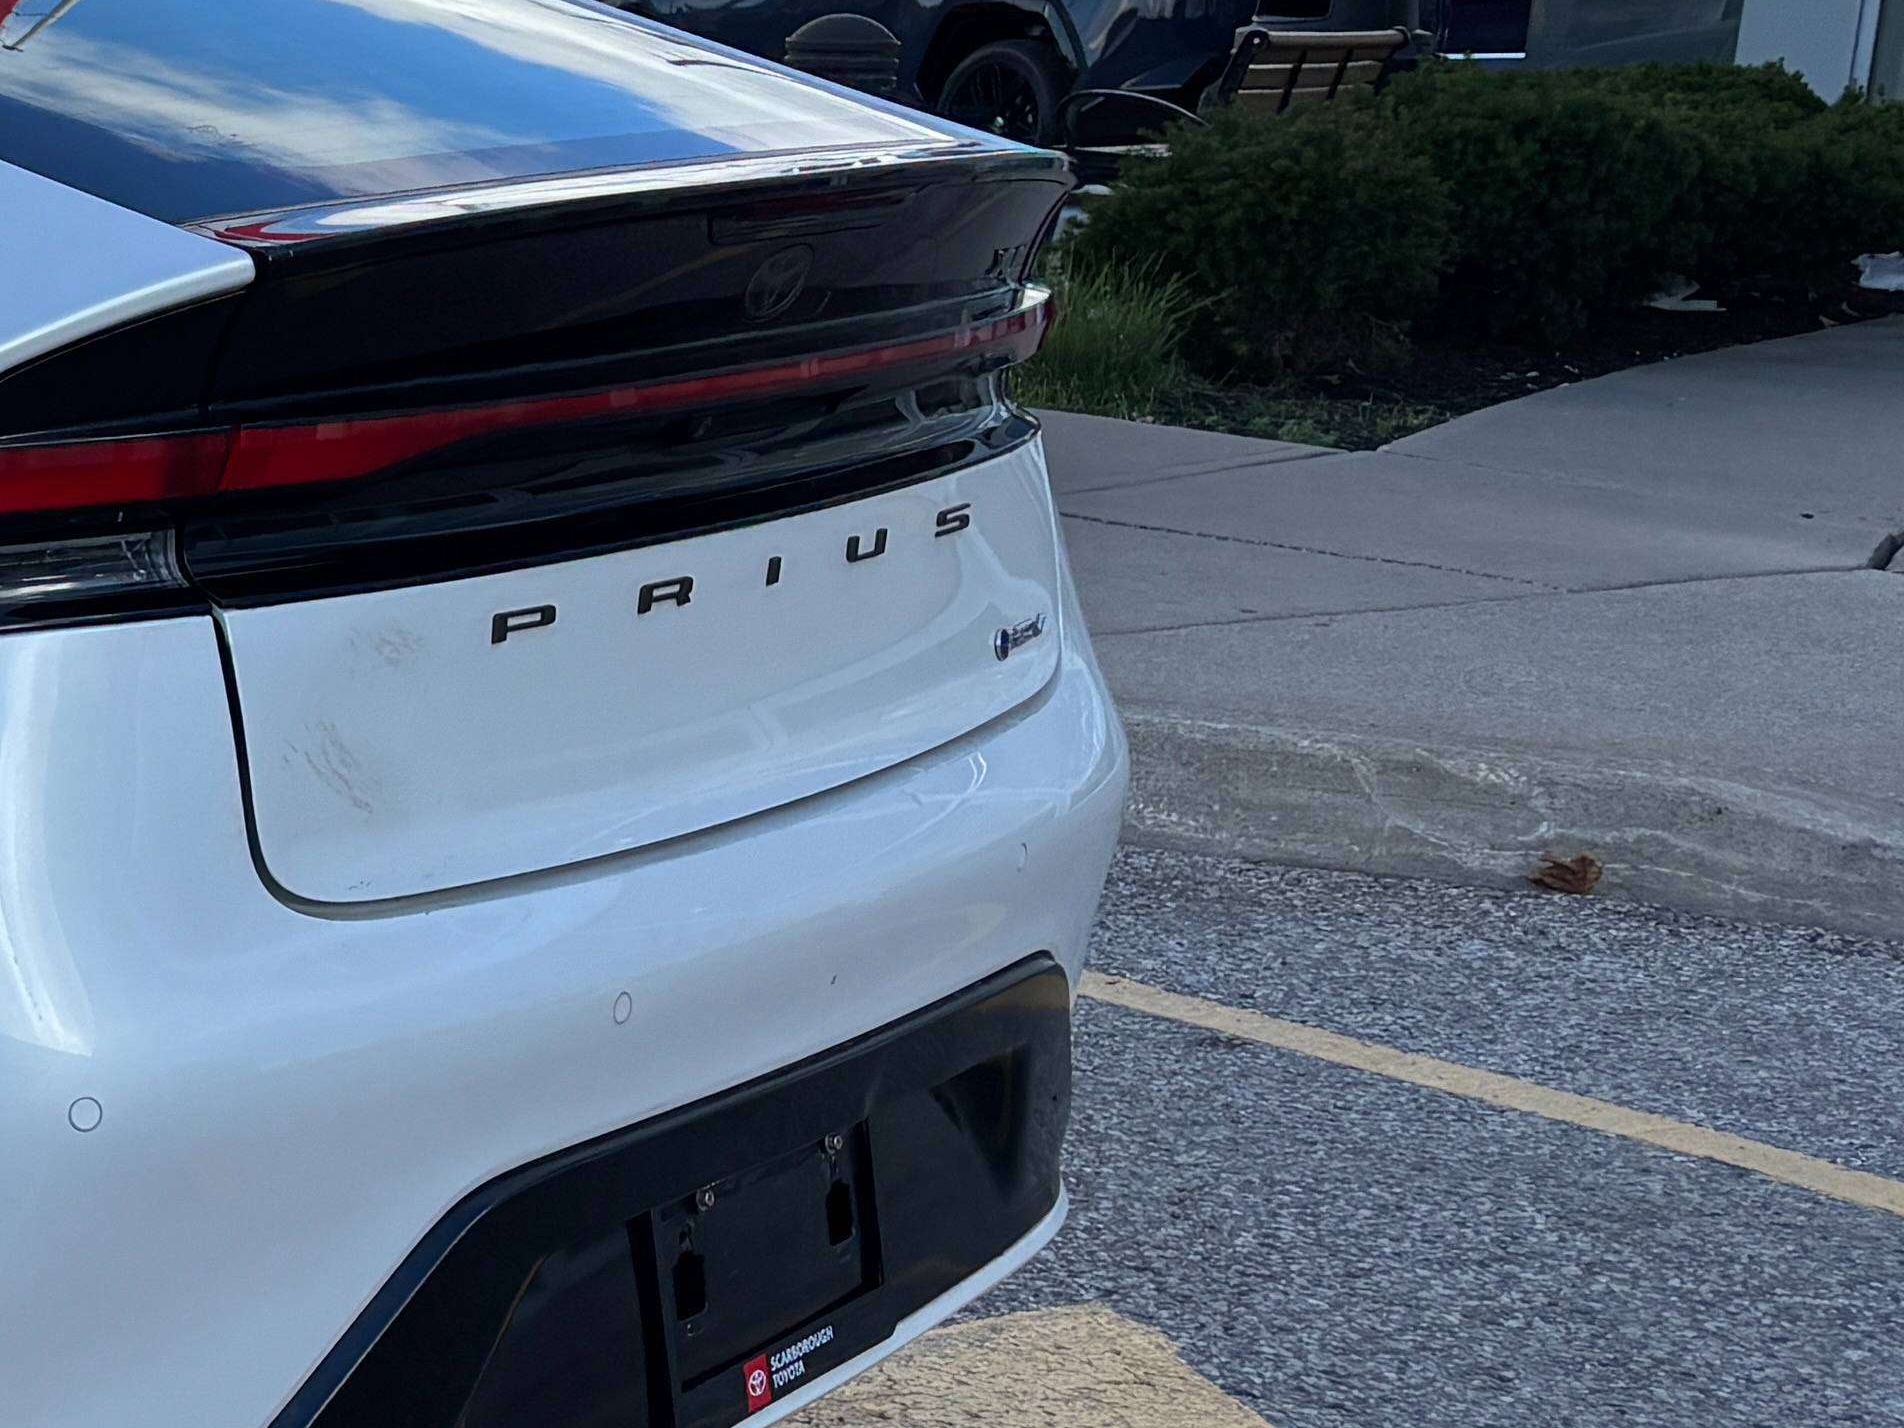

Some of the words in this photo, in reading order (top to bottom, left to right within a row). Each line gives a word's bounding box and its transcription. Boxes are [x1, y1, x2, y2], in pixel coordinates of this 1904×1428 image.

[491, 502, 971, 645] PRIUS
[770, 1325, 834, 1372] SCARBOROUGH
[772, 1359, 806, 1389] TOYOTA
